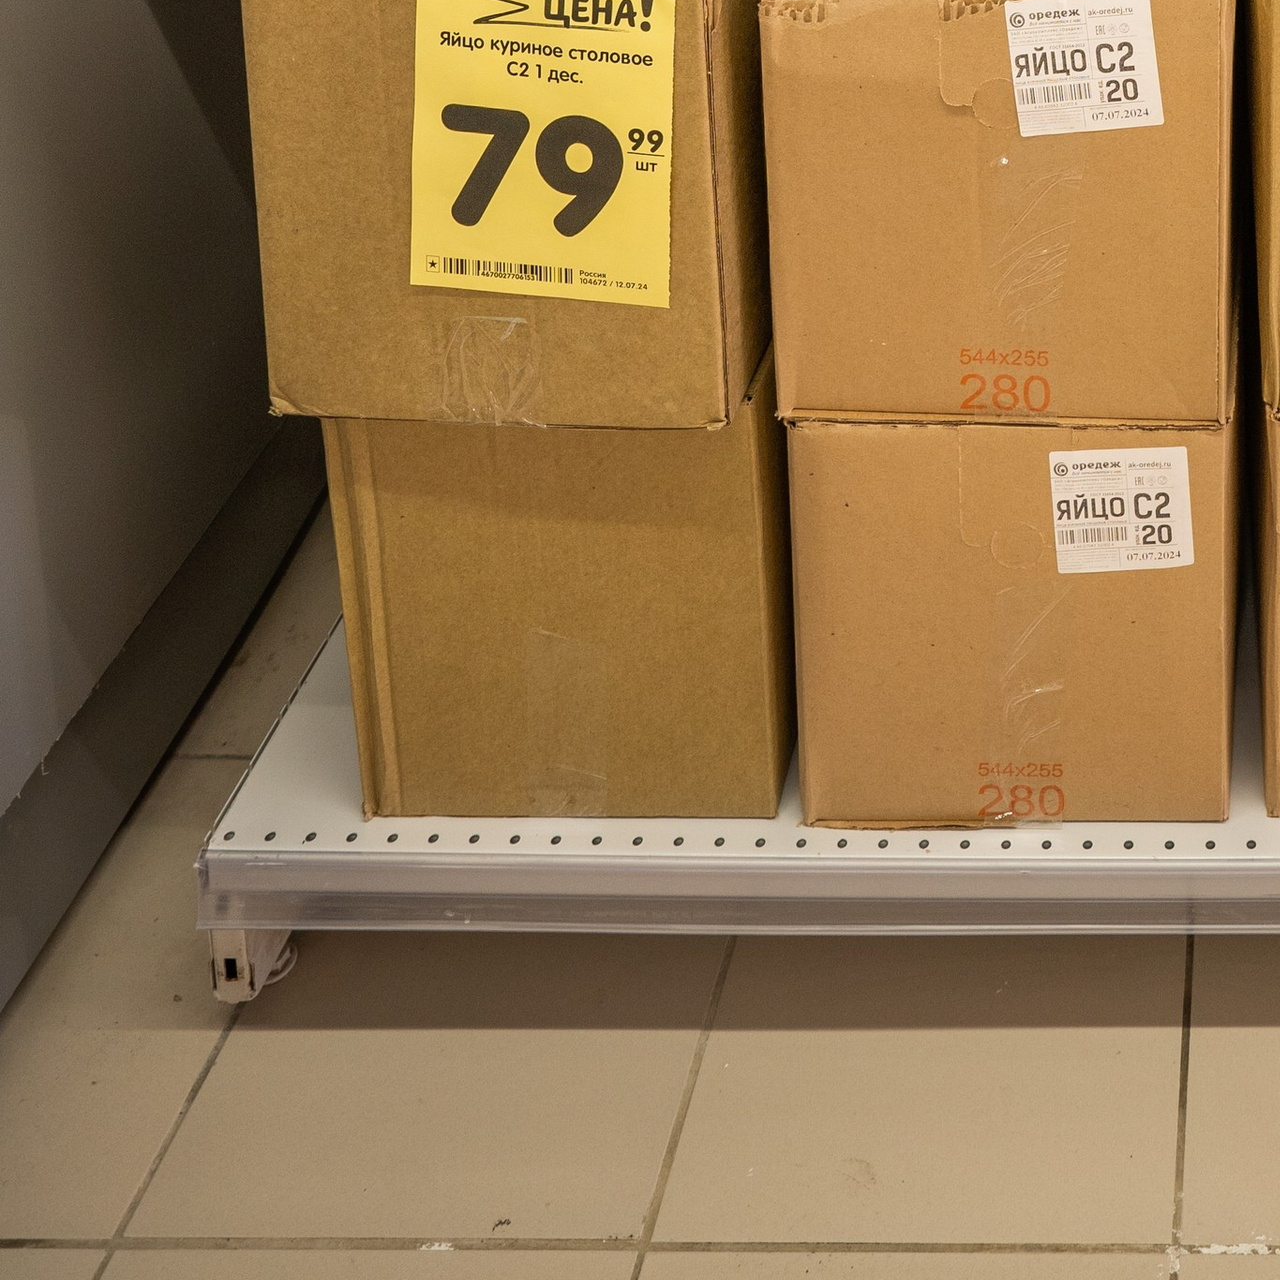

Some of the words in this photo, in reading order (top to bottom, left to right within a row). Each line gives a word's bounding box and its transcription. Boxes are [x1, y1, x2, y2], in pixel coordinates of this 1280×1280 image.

[1029, 9, 1080, 21] оредеж
[1088, 6, 1133, 16] ak-oredej.ru
[439, 31, 486, 53] Яйцо
[489, 39, 564, 62] куриное
[568, 47, 654, 68] столовое
[1014, 46, 1087, 78] ЯЙЦО
[535, 64, 544, 81] 1
[547, 68, 584, 85] дес.
[1106, 78, 1139, 102] 20
[1092, 108, 1149, 121] 07.07.2024
[627, 128, 665, 153] 99
[440, 102, 625, 238] 79
[635, 159, 658, 174] шт
[579, 268, 607, 279] Россия
[958, 372, 1052, 415] 280
[1056, 494, 1125, 520] ЯЙЦО
[1142, 524, 1172, 545] 20
